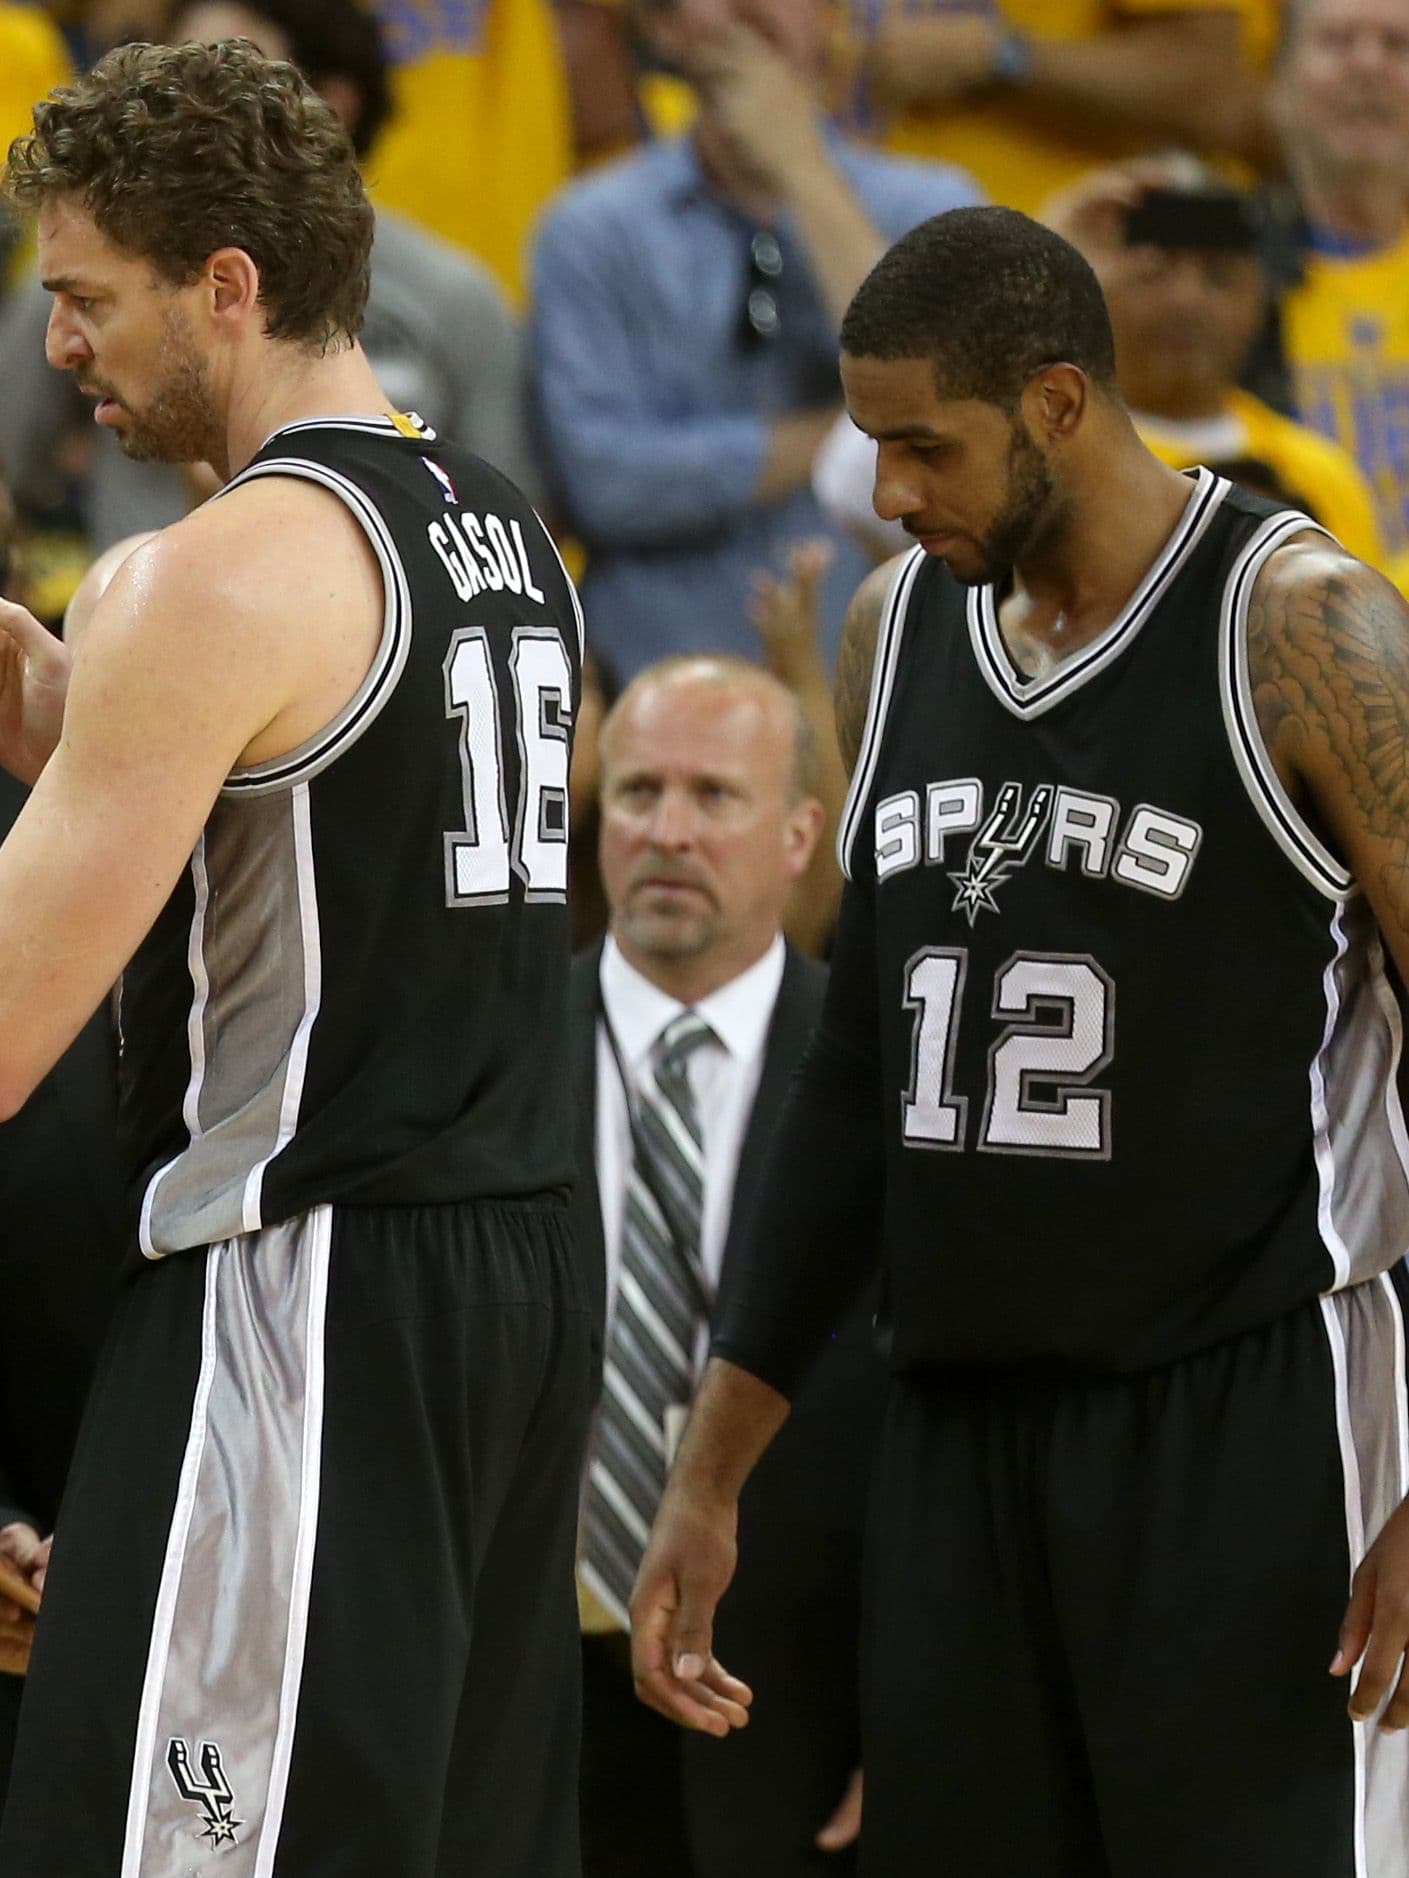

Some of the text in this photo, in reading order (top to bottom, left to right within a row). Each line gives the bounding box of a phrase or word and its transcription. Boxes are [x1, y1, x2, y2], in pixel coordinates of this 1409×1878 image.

[428, 512, 544, 604] GASOL
[442, 625, 572, 909] 16
[874, 777, 1203, 928] SPURS
[900, 945, 1116, 1161] 12
